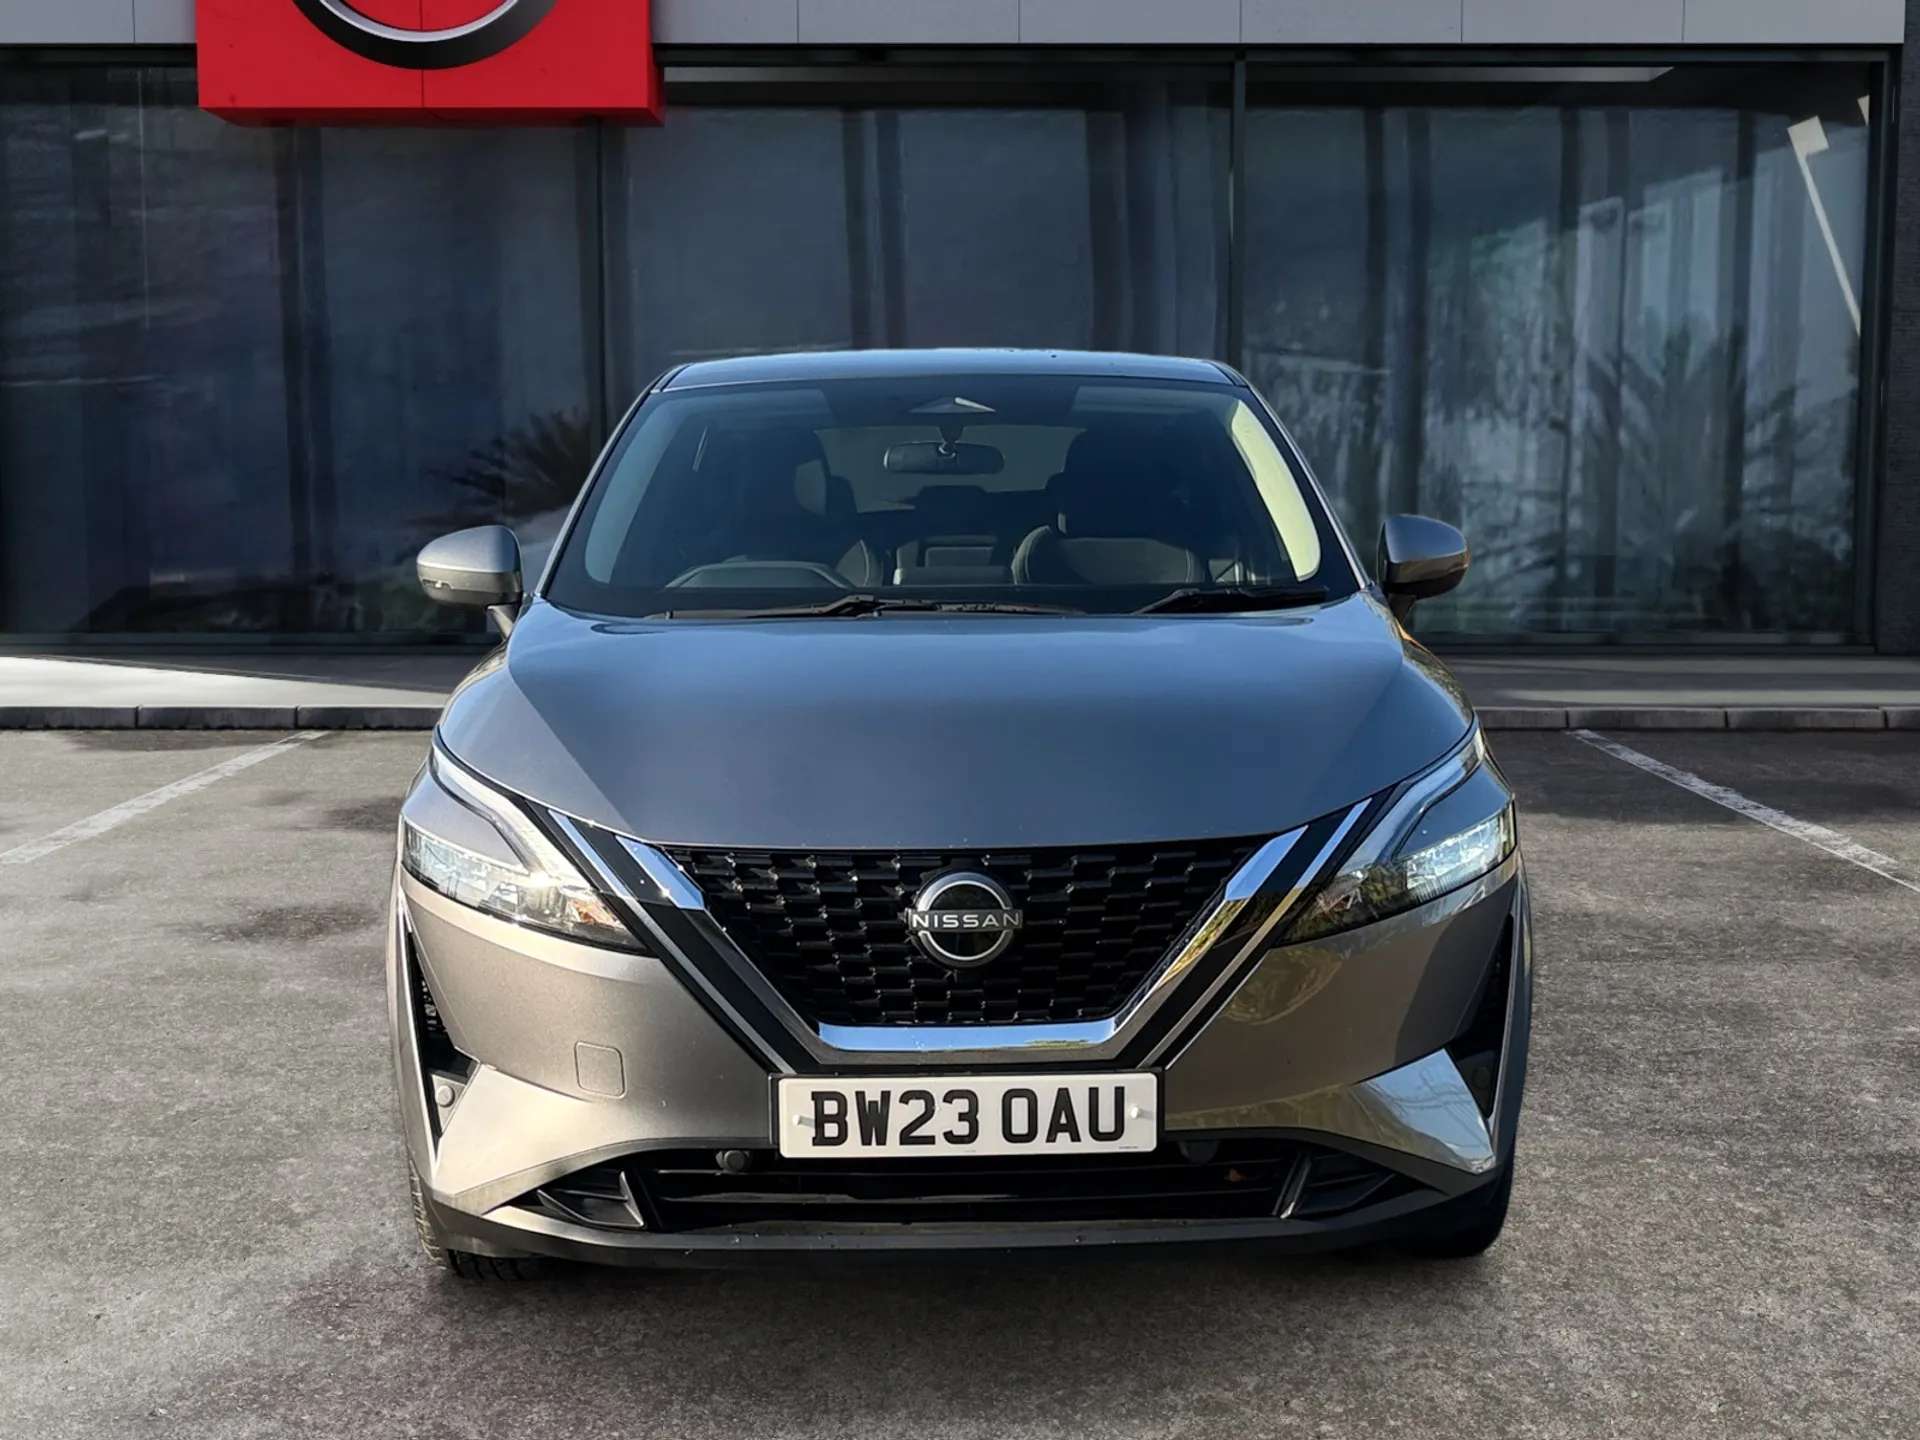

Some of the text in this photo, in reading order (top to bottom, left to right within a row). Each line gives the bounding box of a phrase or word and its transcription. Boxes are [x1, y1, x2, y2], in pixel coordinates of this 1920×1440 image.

[912, 912, 1020, 928] NISSAN
[811, 1086, 1125, 1146] BW23 OAU
